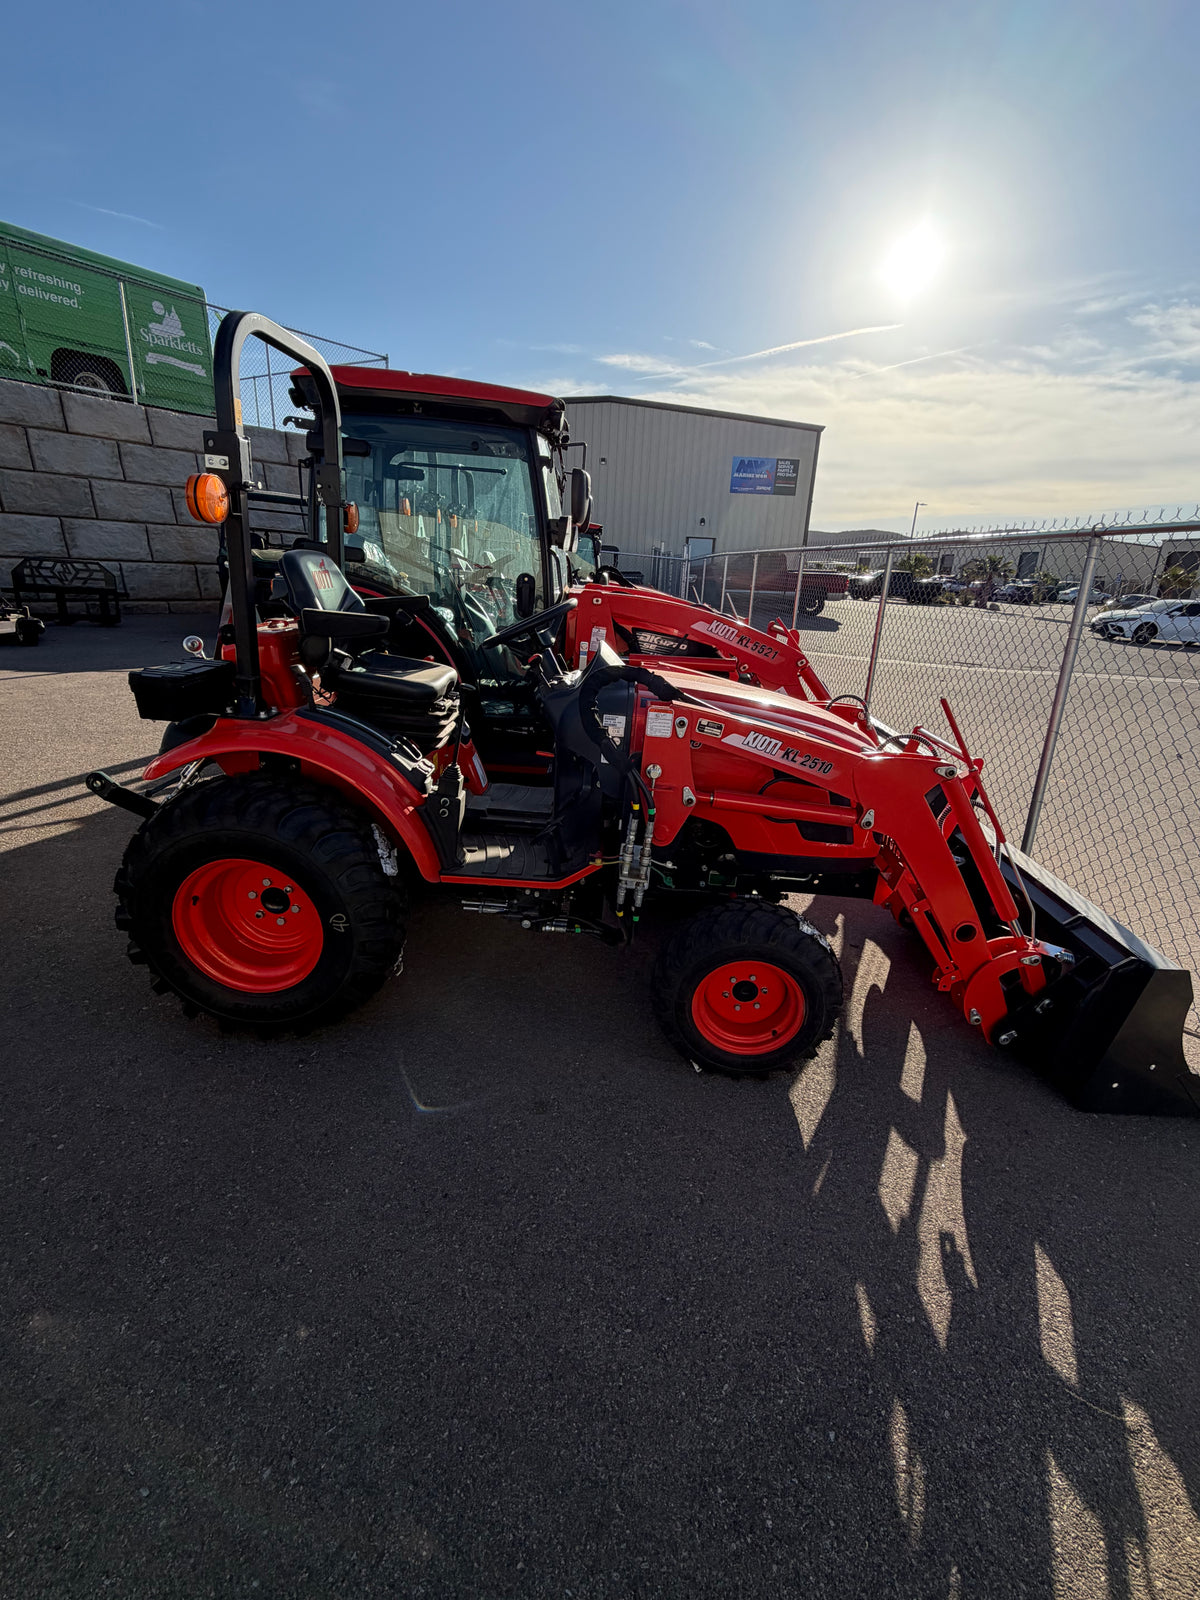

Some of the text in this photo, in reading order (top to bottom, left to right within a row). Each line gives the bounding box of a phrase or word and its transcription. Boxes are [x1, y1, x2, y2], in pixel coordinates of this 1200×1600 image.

[14, 265, 86, 295] refreshing.
[17, 282, 82, 310] delivered.
[140, 327, 203, 356] Sparkletts
[707, 620, 739, 642] KIOTI
[742, 731, 783, 757] KIOTI
